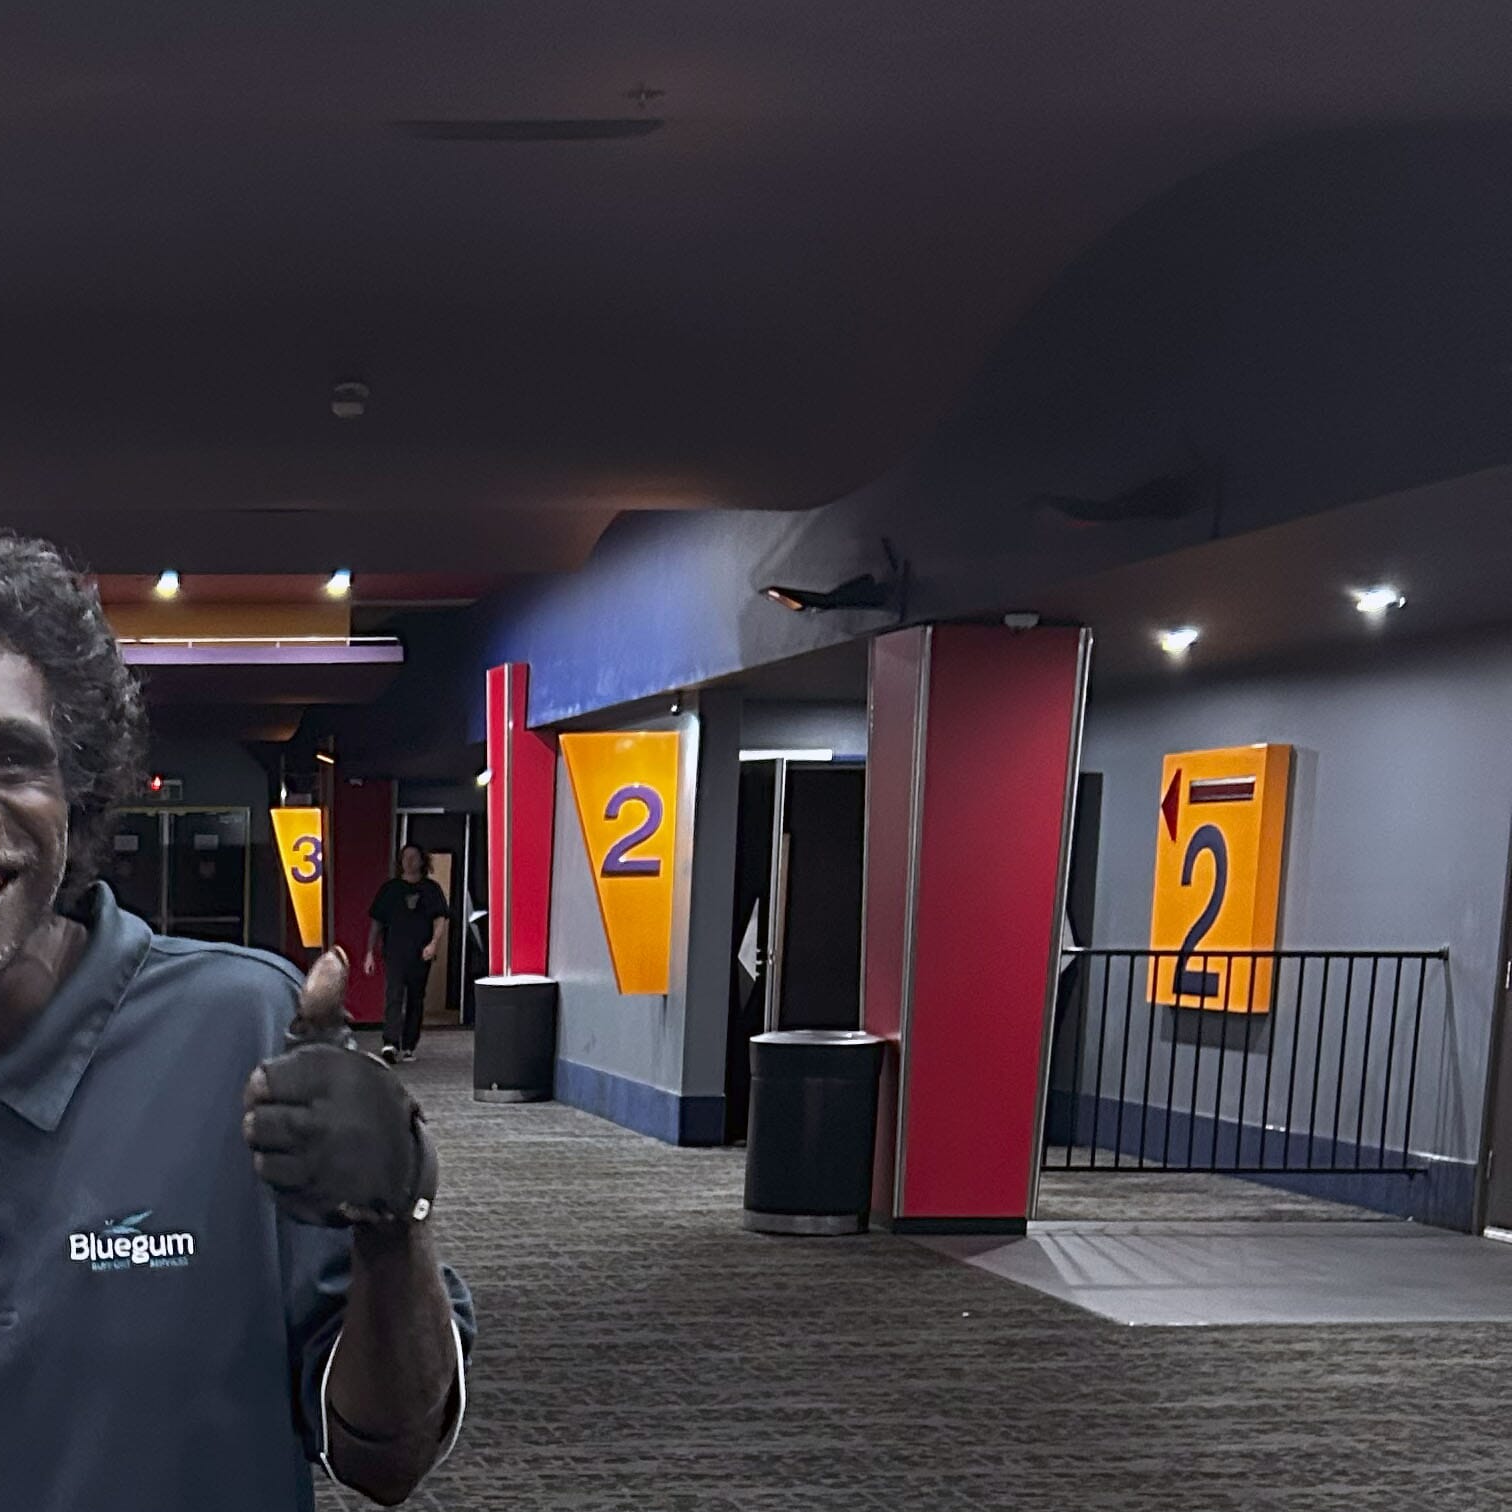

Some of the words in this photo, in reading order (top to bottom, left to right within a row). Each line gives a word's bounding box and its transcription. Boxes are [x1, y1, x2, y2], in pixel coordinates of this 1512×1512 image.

[291, 836, 322, 884] 3
[601, 785, 663, 877] 2
[1173, 824, 1227, 997] 2
[69, 1232, 194, 1264] Bluegum
